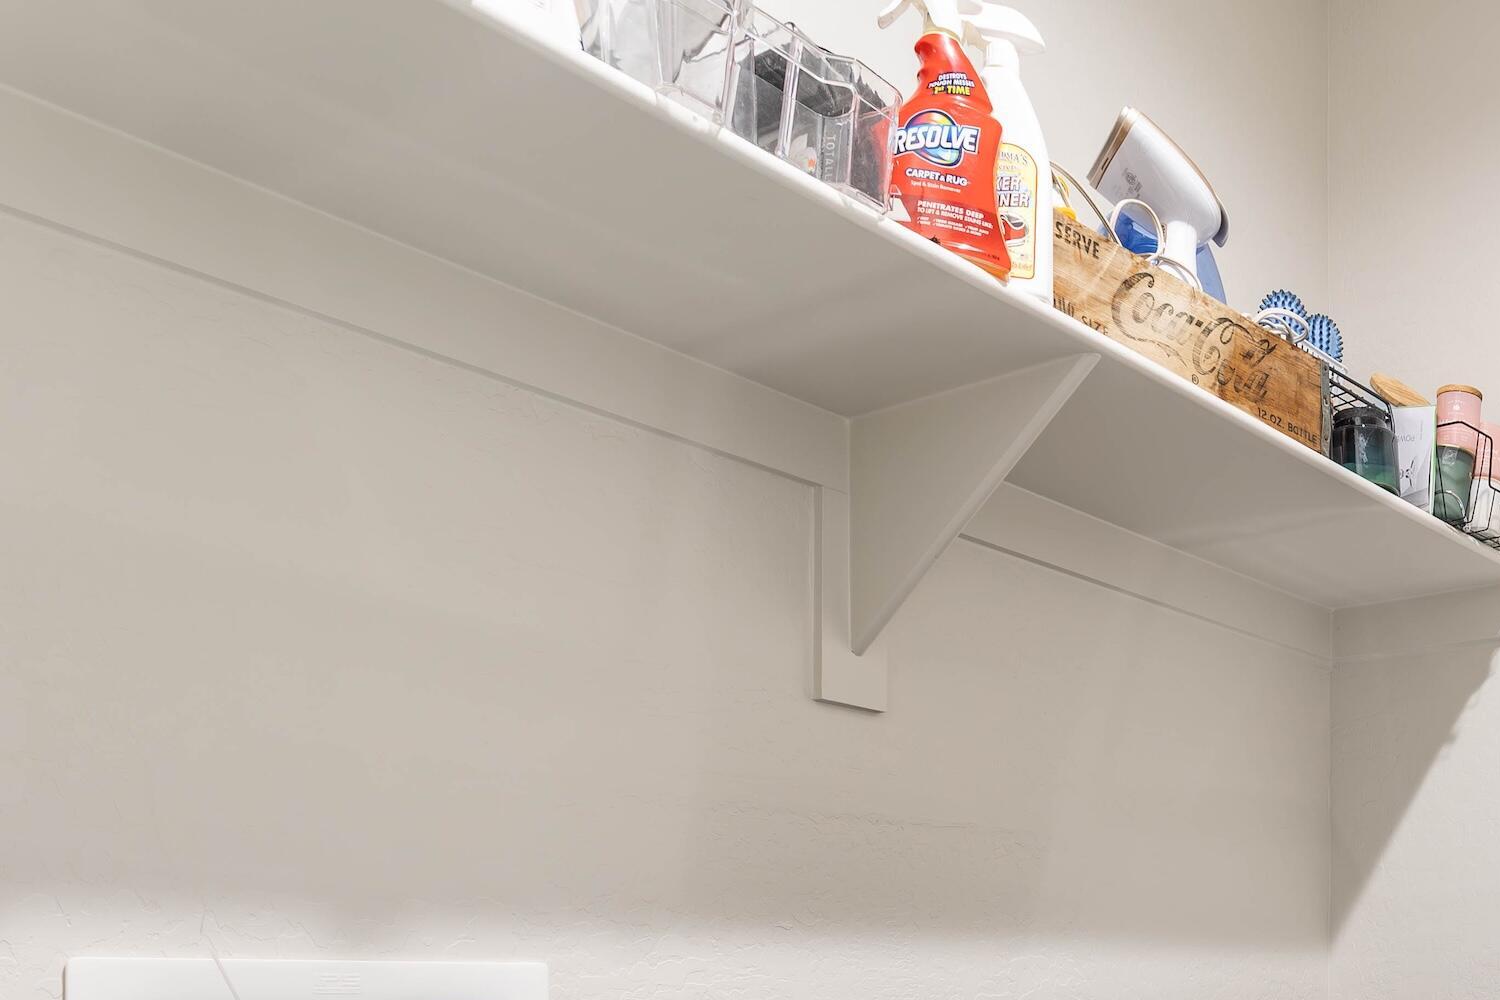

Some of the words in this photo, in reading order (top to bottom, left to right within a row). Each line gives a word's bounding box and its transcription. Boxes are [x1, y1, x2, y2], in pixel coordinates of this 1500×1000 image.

[938, 72, 967, 80] DESTROYS
[946, 86, 970, 95] TIME
[895, 125, 979, 153] RESOLVE
[905, 168, 940, 182] CARPET
[946, 174, 968, 186] RUG
[998, 193, 1029, 207] NER
[917, 200, 963, 215] PENETRATES
[965, 209, 984, 219] DEEP
[941, 210, 963, 220] REMOVE
[1055, 221, 1100, 259] SERVE
[1111, 272, 1277, 402] Coca-Cola
[1287, 422, 1318, 444] BOTTLE
